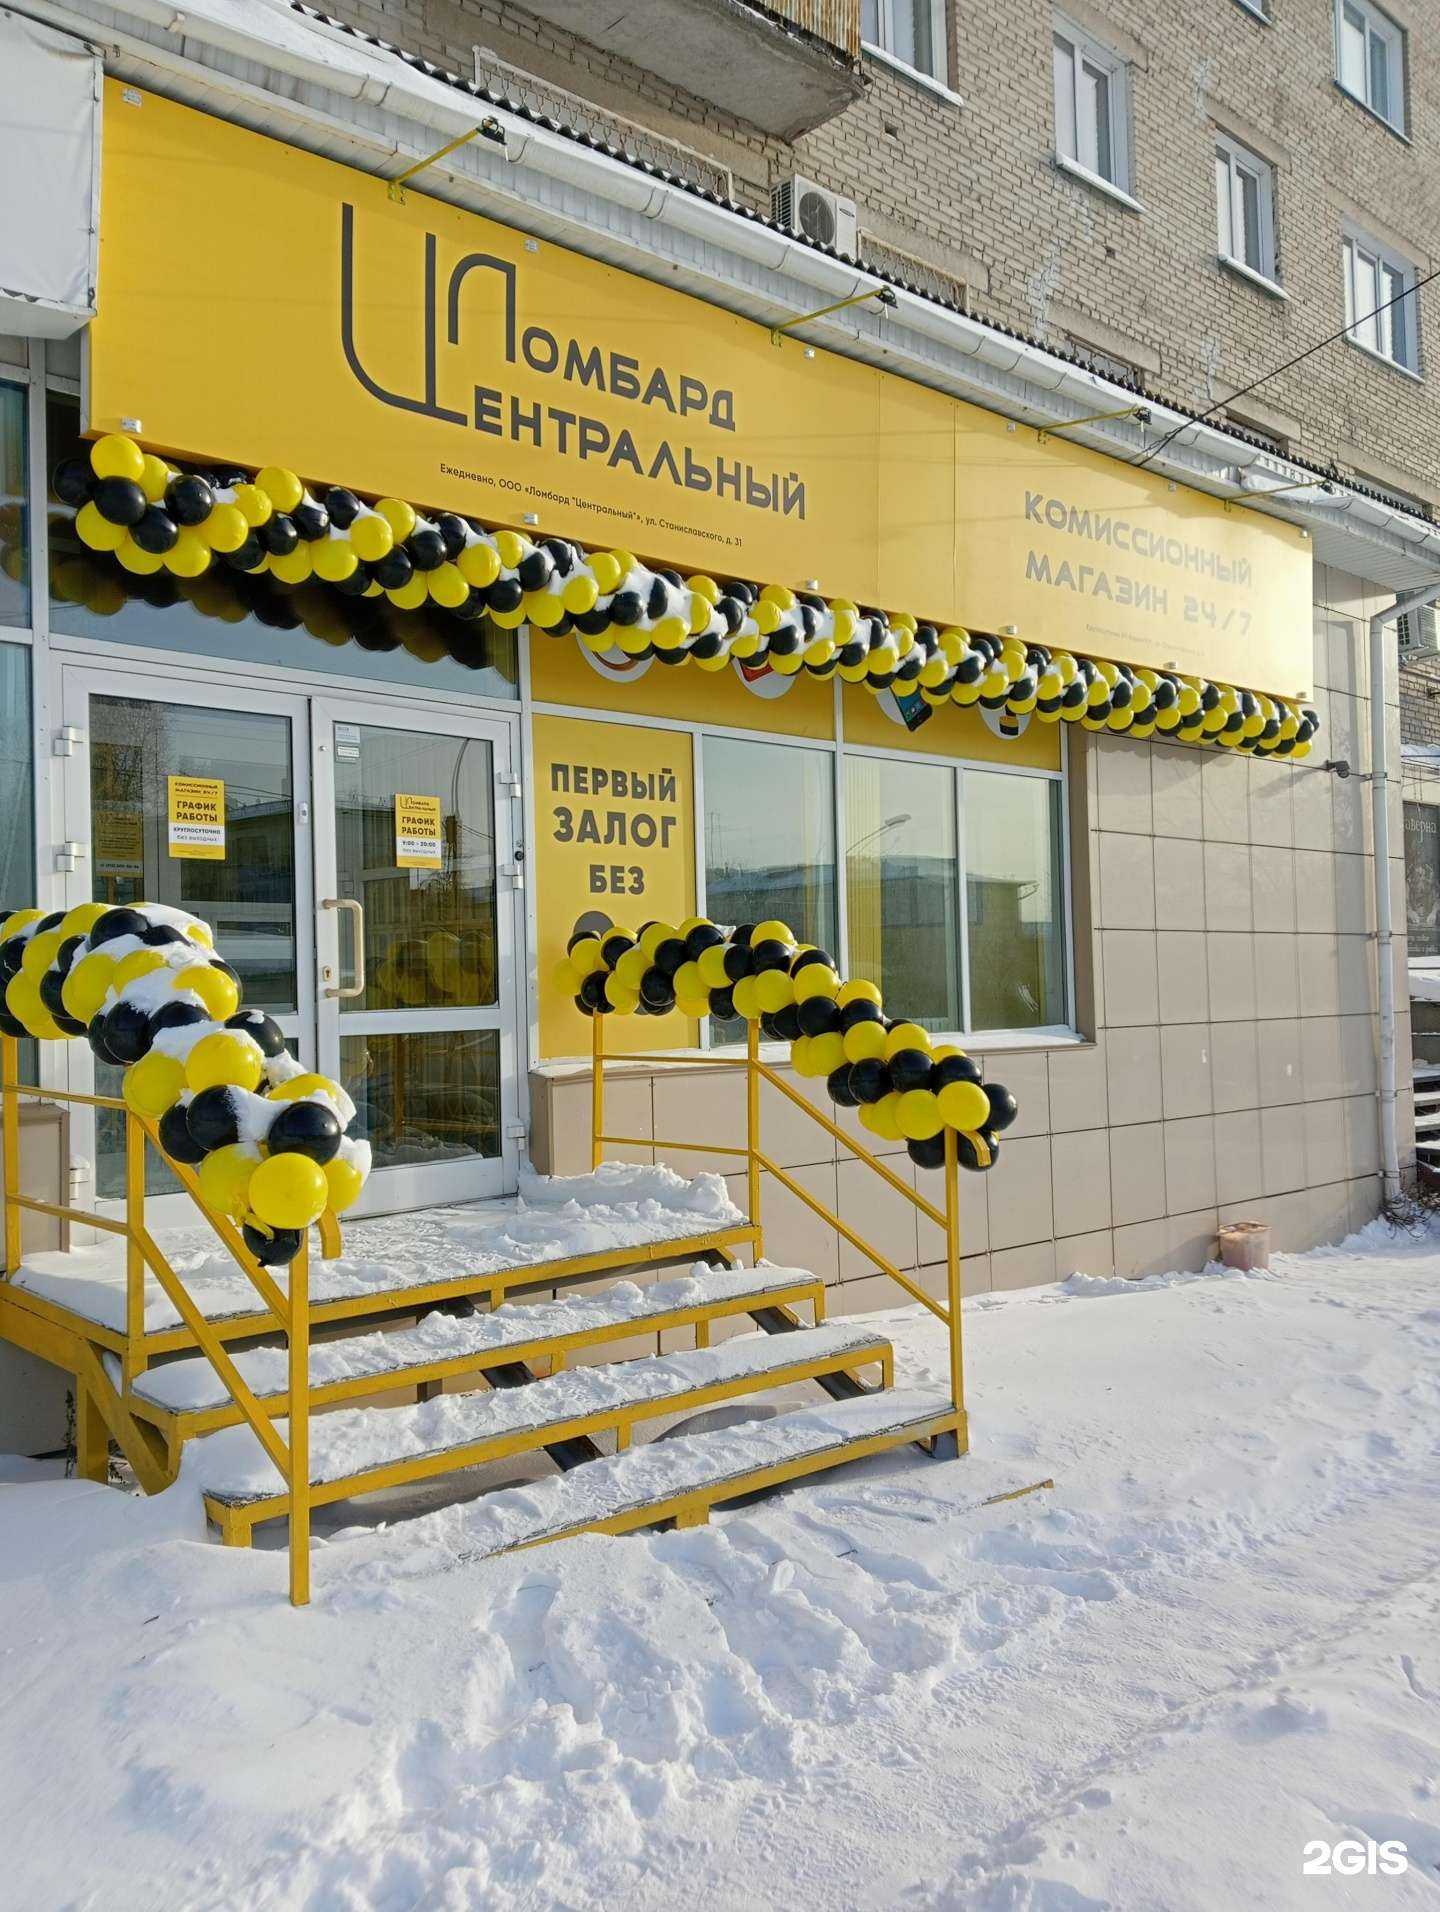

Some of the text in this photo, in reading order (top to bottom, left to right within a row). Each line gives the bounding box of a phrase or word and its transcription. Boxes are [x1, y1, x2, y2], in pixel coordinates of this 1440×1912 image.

[440, 463, 496, 487] Ежедневно,
[499, 478, 522, 492] ООО
[525, 486, 570, 506] «Ломбард
[645, 516, 658, 526] ул.
[659, 518, 724, 544] Станиславского,
[725, 537, 734, 545] д.
[734, 537, 742, 547] 31
[1024, 490, 1251, 588] КОМИССИОННЫЙ
[1025, 550, 1253, 637] МАГАЗИН 24/7
[550, 762, 677, 804] ПЕРВЫЙ
[176, 811, 217, 822] РАБОТЫ
[177, 800, 216, 811] ГРАФИК
[402, 816, 435, 826] ГРАФИК
[401, 826, 436, 836] РАБОТЫ
[552, 806, 677, 849] ЗАЛОГ
[589, 864, 645, 895] БЕЗ
